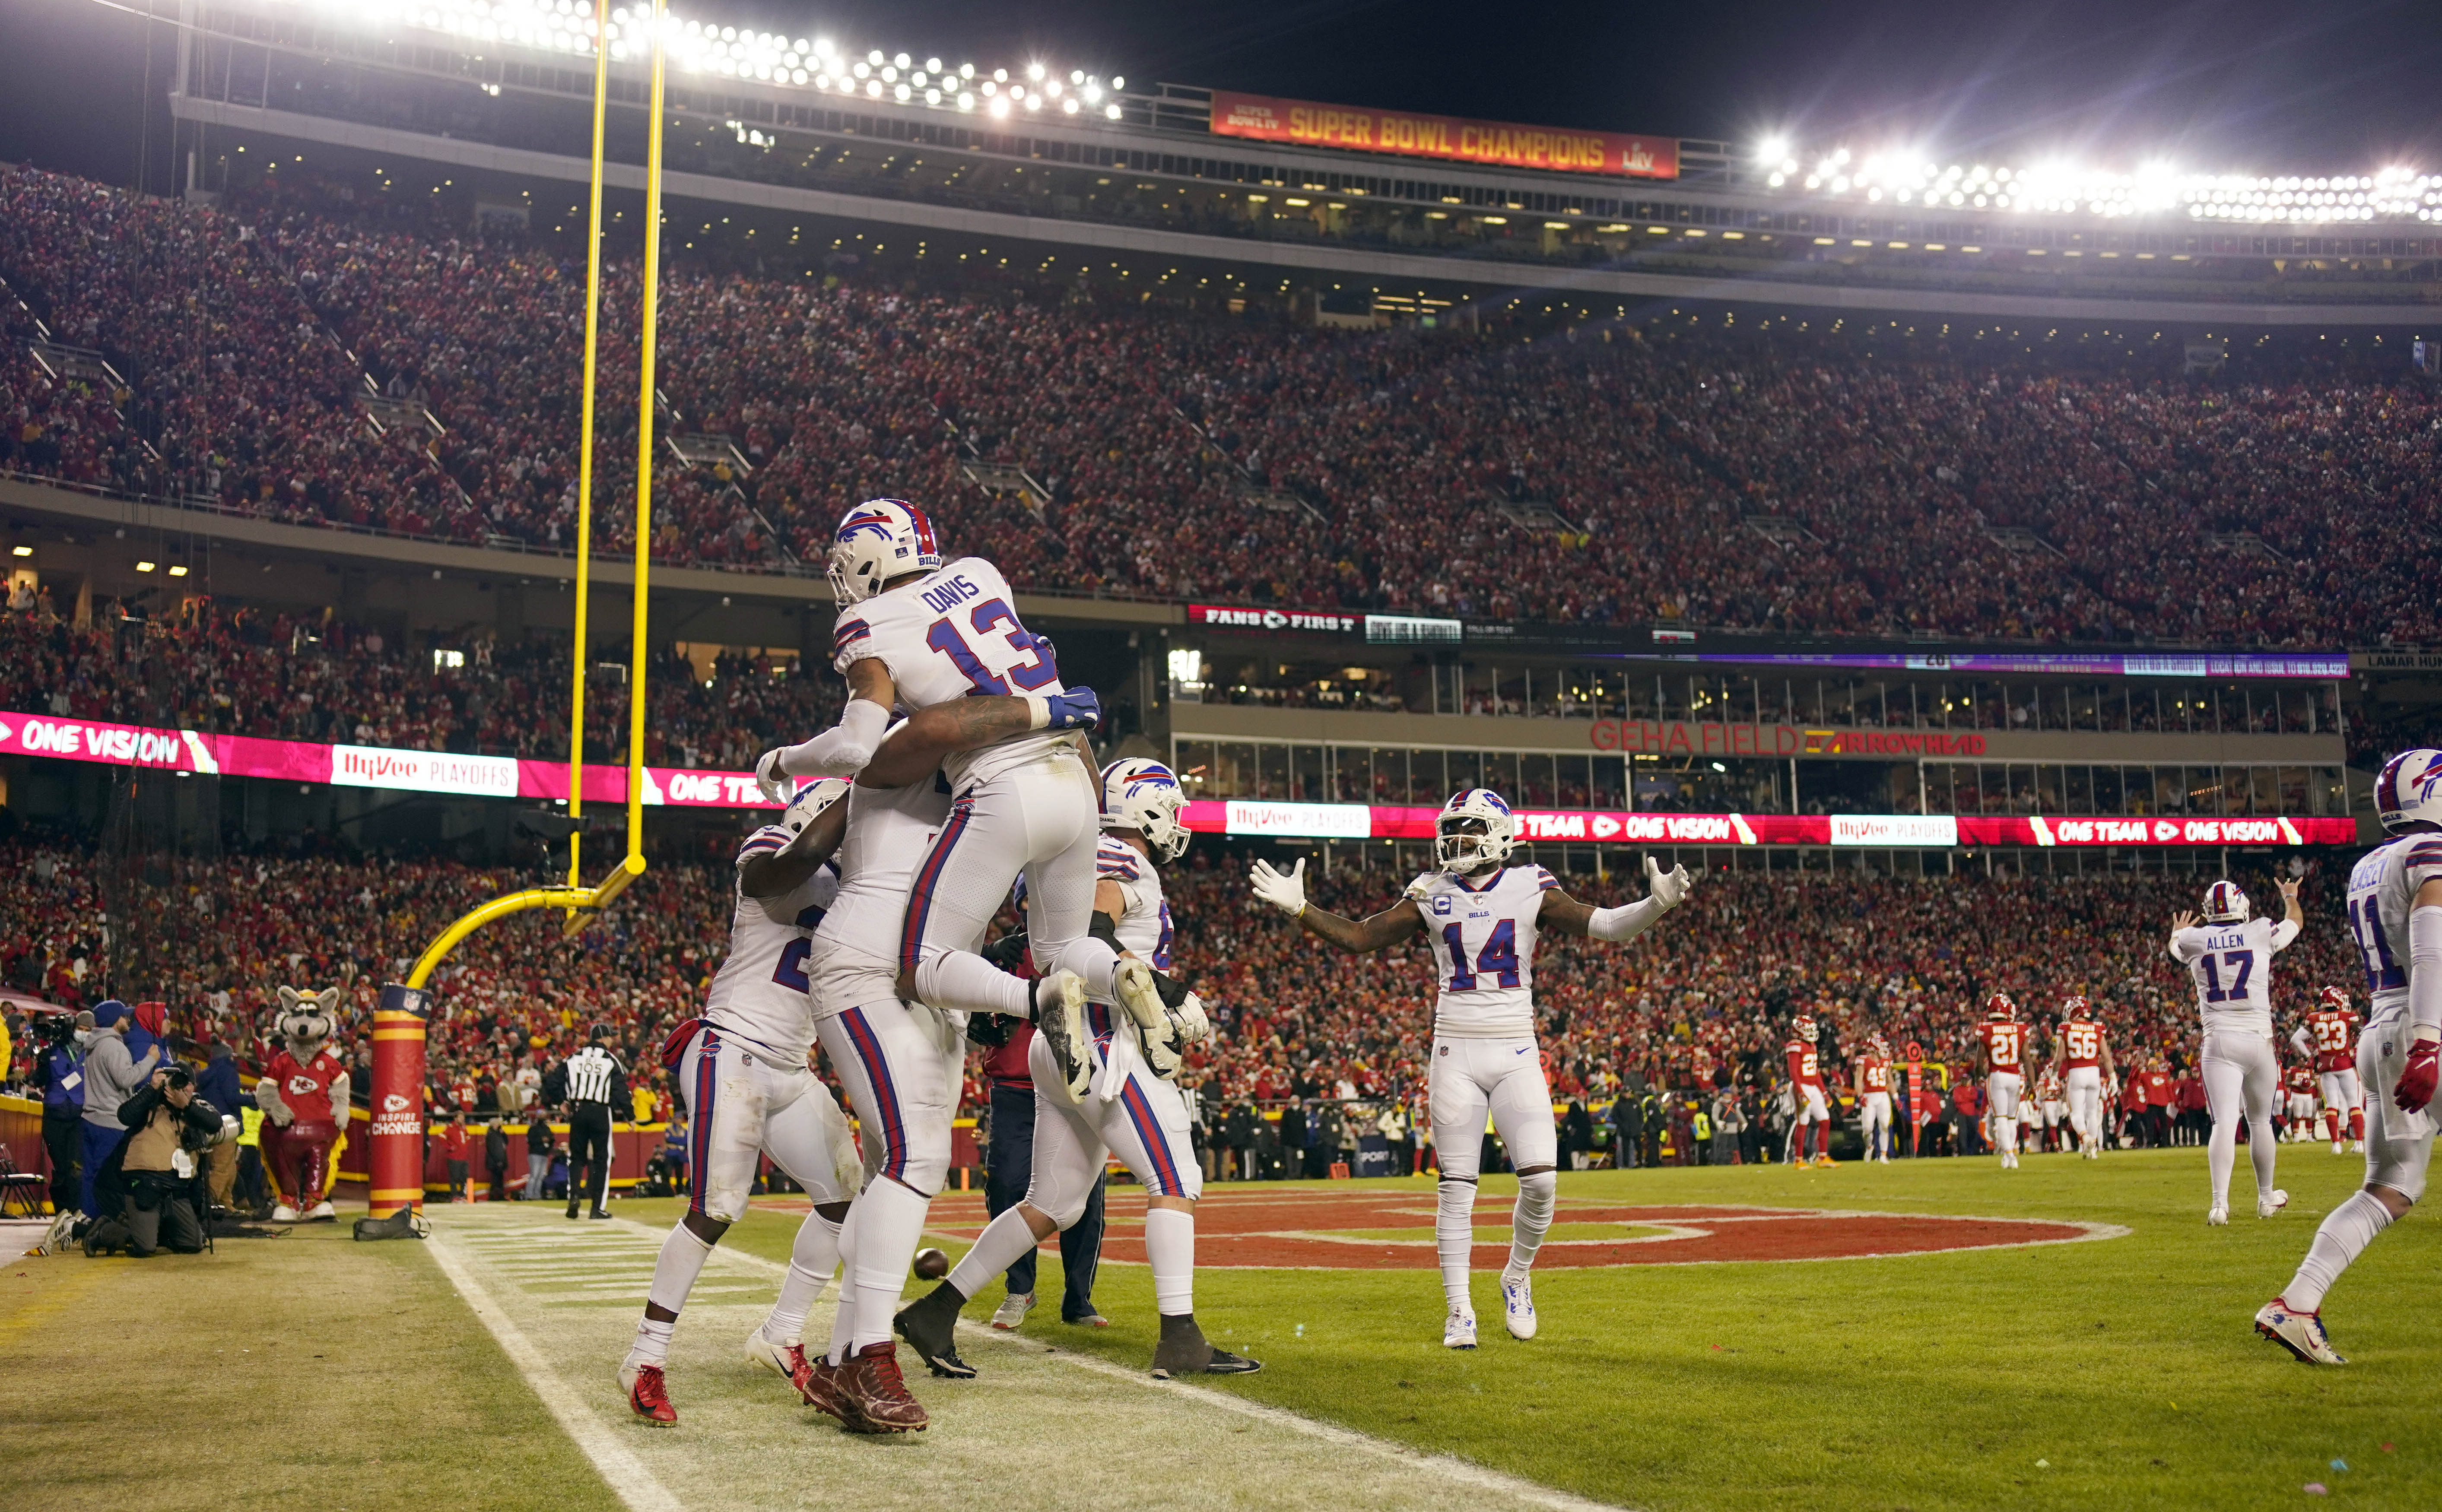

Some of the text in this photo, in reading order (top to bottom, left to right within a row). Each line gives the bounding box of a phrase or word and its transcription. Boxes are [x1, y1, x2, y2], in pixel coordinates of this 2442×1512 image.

[1289, 107, 1605, 168] SUPER BOWL CHAMPIONS
[918, 556, 941, 566] BILLS
[921, 574, 980, 614] DAVIS
[1205, 608, 1261, 626] FANS
[1291, 613, 1355, 632] FIRST
[926, 597, 1057, 697] 13
[2368, 655, 2415, 667] LAMAR
[22, 720, 179, 764] ONE VISION
[1591, 720, 1694, 752] GEHA
[1703, 724, 1799, 755] FIELD
[1825, 732, 1987, 755] ARROWHEAD
[344, 752, 509, 787] HyVee PLAYOFFS
[669, 773, 721, 802] ONE
[1302, 812, 1362, 829] PLAYOFFS
[1526, 815, 1585, 838] TEAM
[1626, 816, 1664, 839] ONE
[1667, 817, 1730, 840] VISION
[1897, 822, 1951, 838] PLAYOFFS
[2058, 821, 2278, 842] ONE TEAM ONE VISION
[2348, 857, 2388, 893] EASLEY
[1468, 910, 1489, 919] BILLS
[1442, 919, 1521, 992] 14
[2207, 934, 2244, 951] ALLEN
[2349, 894, 2408, 993] 11
[2201, 950, 2254, 1003] 17
[1991, 1034, 2019, 1065] 21
[2067, 1031, 2098, 1060] 56
[2314, 1019, 2347, 1051] 23
[577, 1062, 602, 1074] 105
[372, 1121, 421, 1136] CHANGE
[378, 1112, 416, 1122] INSPIRE
